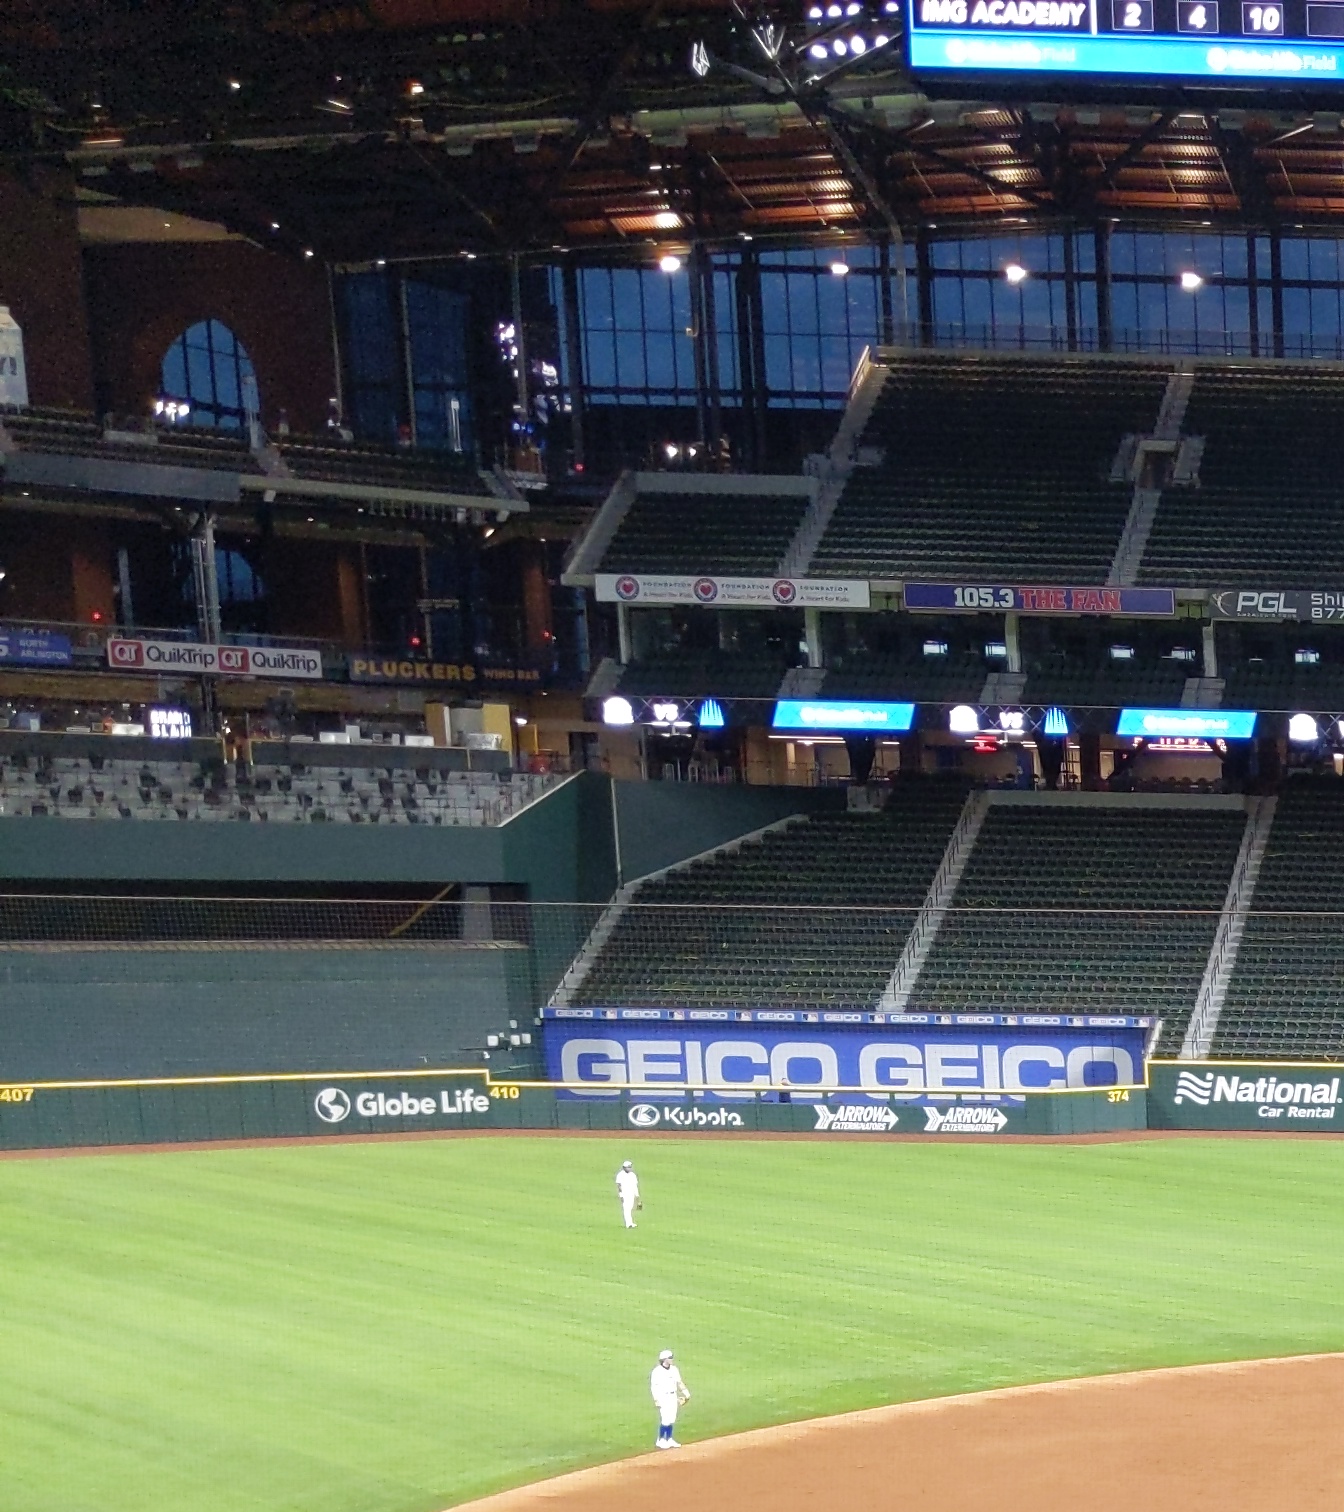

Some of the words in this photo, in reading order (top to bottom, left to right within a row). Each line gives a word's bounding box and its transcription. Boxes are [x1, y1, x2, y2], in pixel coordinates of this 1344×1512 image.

[922, 0, 968, 23] IMG
[971, 1, 1086, 26] ACADEMY
[1124, 3, 1141, 27] 2
[1188, 5, 1206, 29] 4
[1250, 7, 1279, 31] 10
[1303, 54, 1336, 71] Field
[954, 587, 1014, 608] 105.3
[1019, 589, 1067, 610] THE
[1072, 590, 1122, 611] FAN
[1236, 592, 1297, 613] PGL
[147, 645, 215, 668] QuikTrip
[252, 651, 318, 674] QuikTrip
[354, 659, 477, 682] PLUCKERS
[556, 1009, 593, 1018] GEICO
[622, 1010, 661, 1019] GEICO
[690, 1011, 728, 1020] GEICO
[757, 1012, 795, 1021] GEICO
[824, 1013, 861, 1022] GEICO
[890, 1014, 928, 1023] GEICO
[957, 1015, 994, 1024] GEICO
[1023, 1016, 1060, 1025] GEICO
[1089, 1017, 1126, 1026] GEICO
[561, 1039, 838, 1099] GEICO
[859, 1043, 1134, 1100] GEICO
[0, 1088, 34, 1102] 407
[490, 1087, 520, 1099] 410
[1107, 1090, 1130, 1103] 374
[1213, 1075, 1340, 1104] National
[356, 1092, 437, 1116] Globe
[441, 1090, 490, 1114] Life
[665, 1106, 742, 1126] Kubota
[832, 1105, 886, 1122] ARROW
[943, 1107, 995, 1123] ARROW
[1258, 1106, 1284, 1118] Car
[1287, 1106, 1335, 1119] Rental
[941, 1123, 995, 1132] EXTERMINATORS
